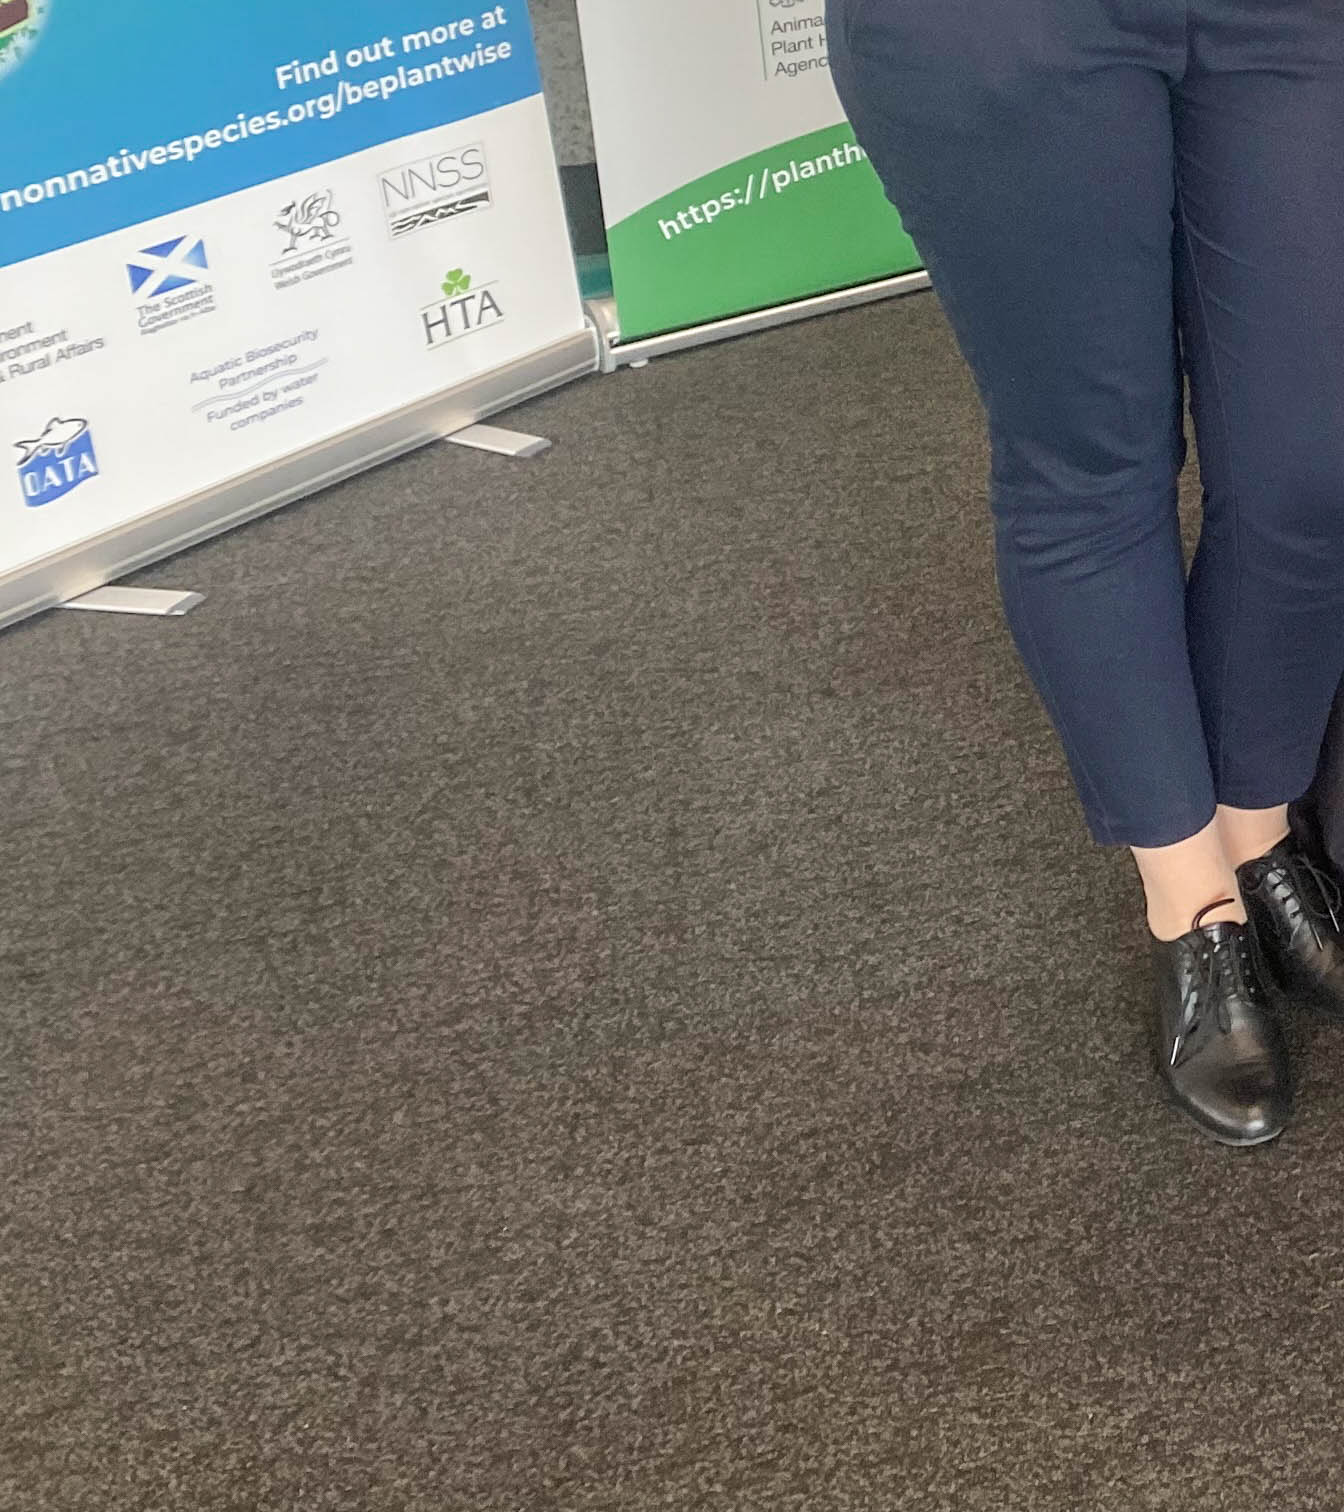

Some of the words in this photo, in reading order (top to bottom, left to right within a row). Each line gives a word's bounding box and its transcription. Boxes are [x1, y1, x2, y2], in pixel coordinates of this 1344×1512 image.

[275, 51, 339, 90] Find
[346, 35, 395, 69] out
[402, 16, 475, 53] more
[482, 4, 507, 30] at
[1, 39, 513, 212] nonnativespecies.org/beplantwise
[381, 147, 485, 207] NNSS
[421, 294, 504, 345] HTA
[8, 354, 51, 379] Rural
[55, 337, 105, 364] Affairs
